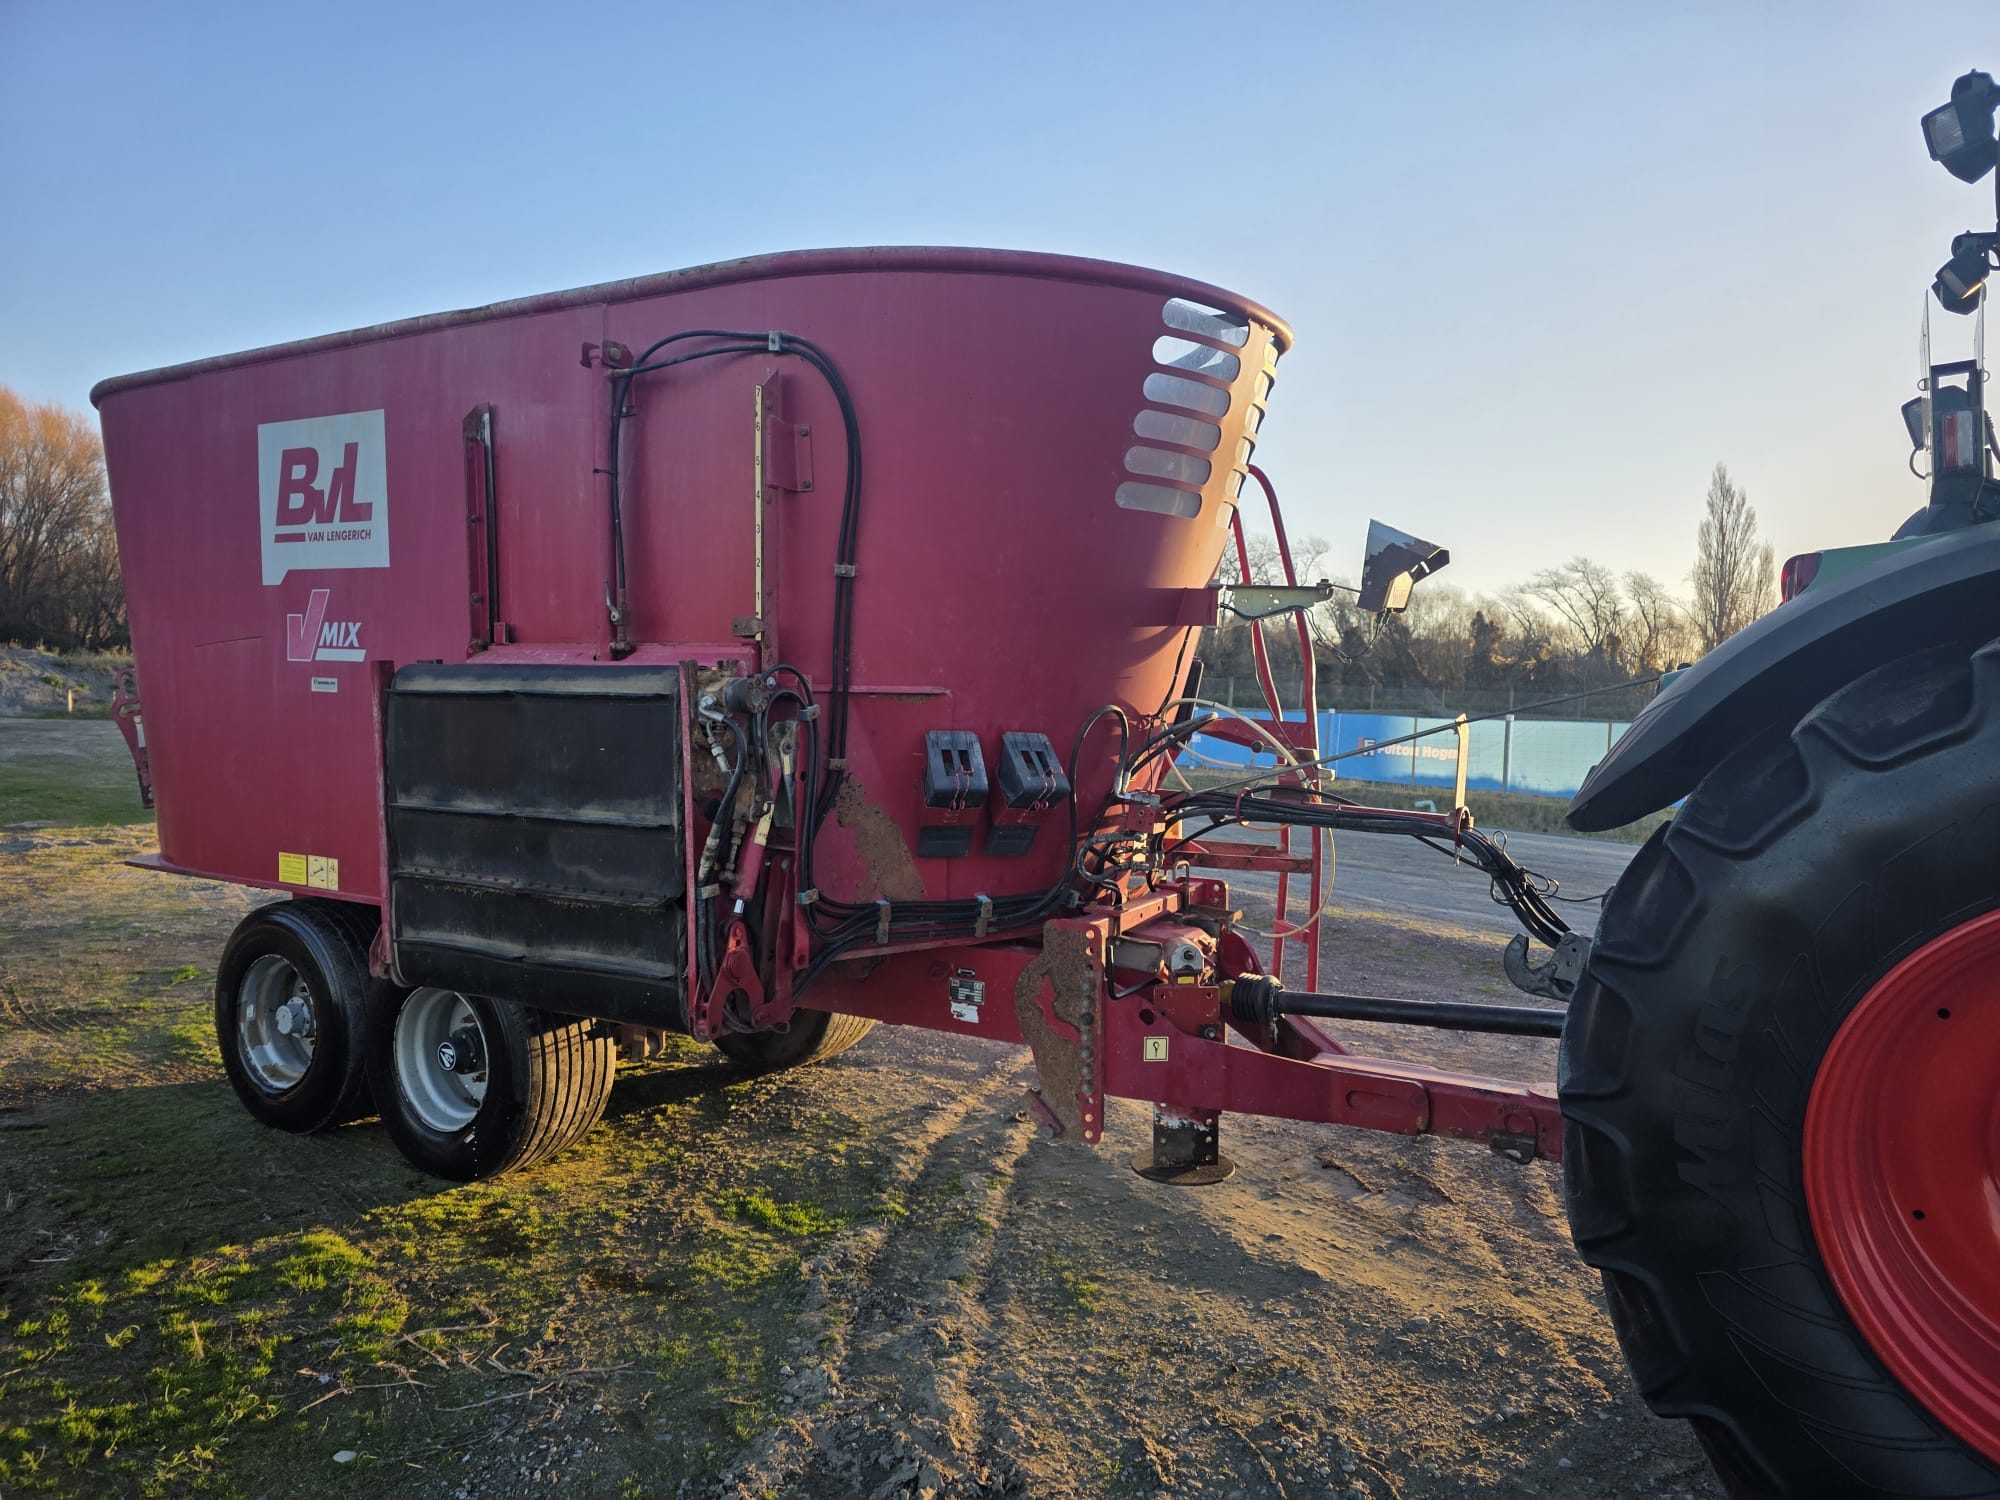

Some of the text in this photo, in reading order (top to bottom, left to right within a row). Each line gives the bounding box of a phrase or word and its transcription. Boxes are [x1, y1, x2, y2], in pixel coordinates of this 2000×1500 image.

[307, 529, 372, 543] VAN LENGERICH
[318, 621, 363, 648] MIX
[1423, 746, 1459, 761] Hoga
